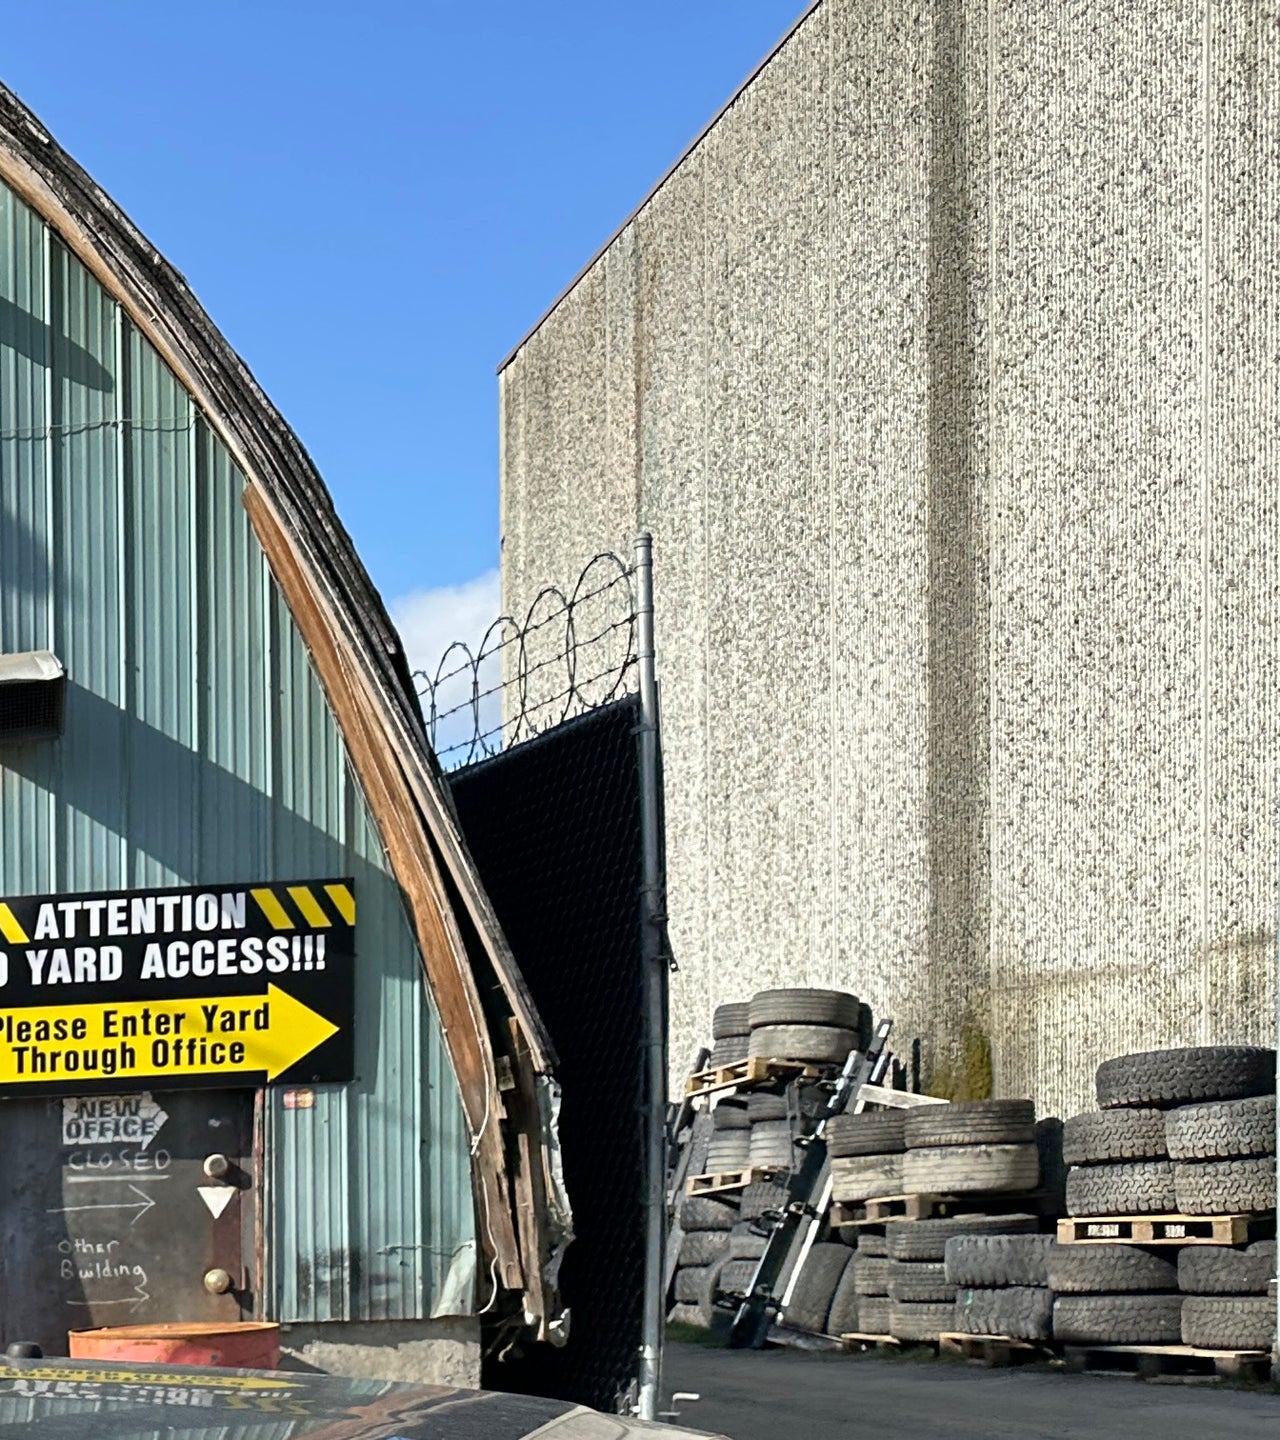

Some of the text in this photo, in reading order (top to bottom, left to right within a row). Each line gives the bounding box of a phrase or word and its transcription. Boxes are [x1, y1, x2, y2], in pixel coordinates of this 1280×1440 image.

[33, 891, 247, 941] ATTENTION
[26, 945, 124, 986] YARD
[140, 933, 327, 979] ACCESS!!!
[103, 1008, 187, 1039] Enter
[201, 1001, 271, 1032] Yard
[11, 1037, 246, 1075] Through Office
[75, 1099, 141, 1118] NEW
[65, 1117, 158, 1141] OFFICE
[67, 1149, 172, 1171] CLOSED
[58, 1238, 120, 1254] Other
[60, 1258, 148, 1287] Building
